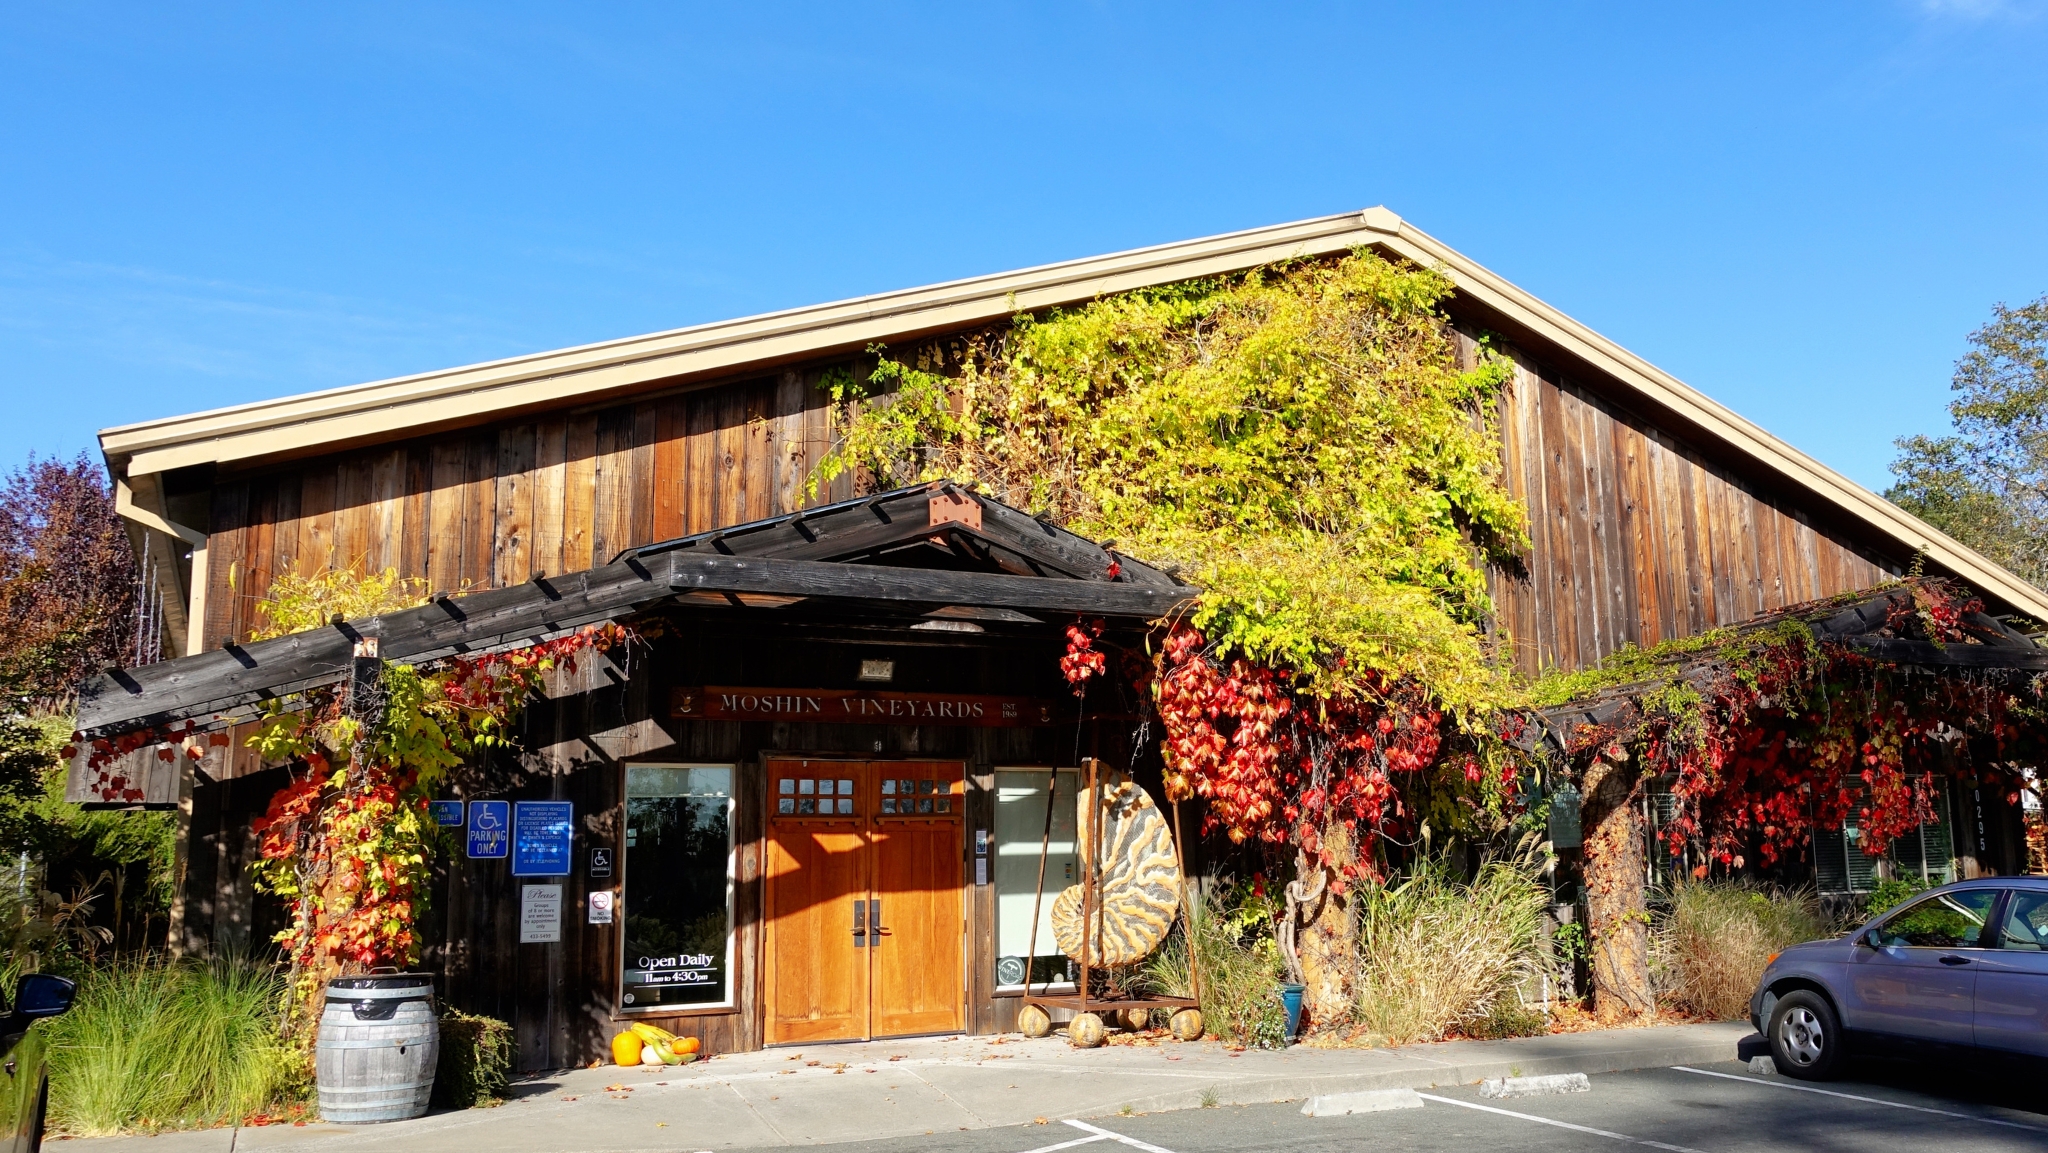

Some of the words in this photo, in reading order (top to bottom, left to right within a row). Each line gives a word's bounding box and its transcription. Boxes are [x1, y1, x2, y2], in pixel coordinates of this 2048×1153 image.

[720, 694, 821, 713] MOSHIN
[842, 698, 984, 718] VINEYARDS
[470, 830, 506, 841] PARKING
[476, 843, 498, 854] ONLY
[527, 889, 556, 899] Please
[638, 956, 676, 970] Open
[680, 954, 714, 967] Daily
[645, 974, 663, 982] 11am
[672, 971, 708, 982] 4:30pm
